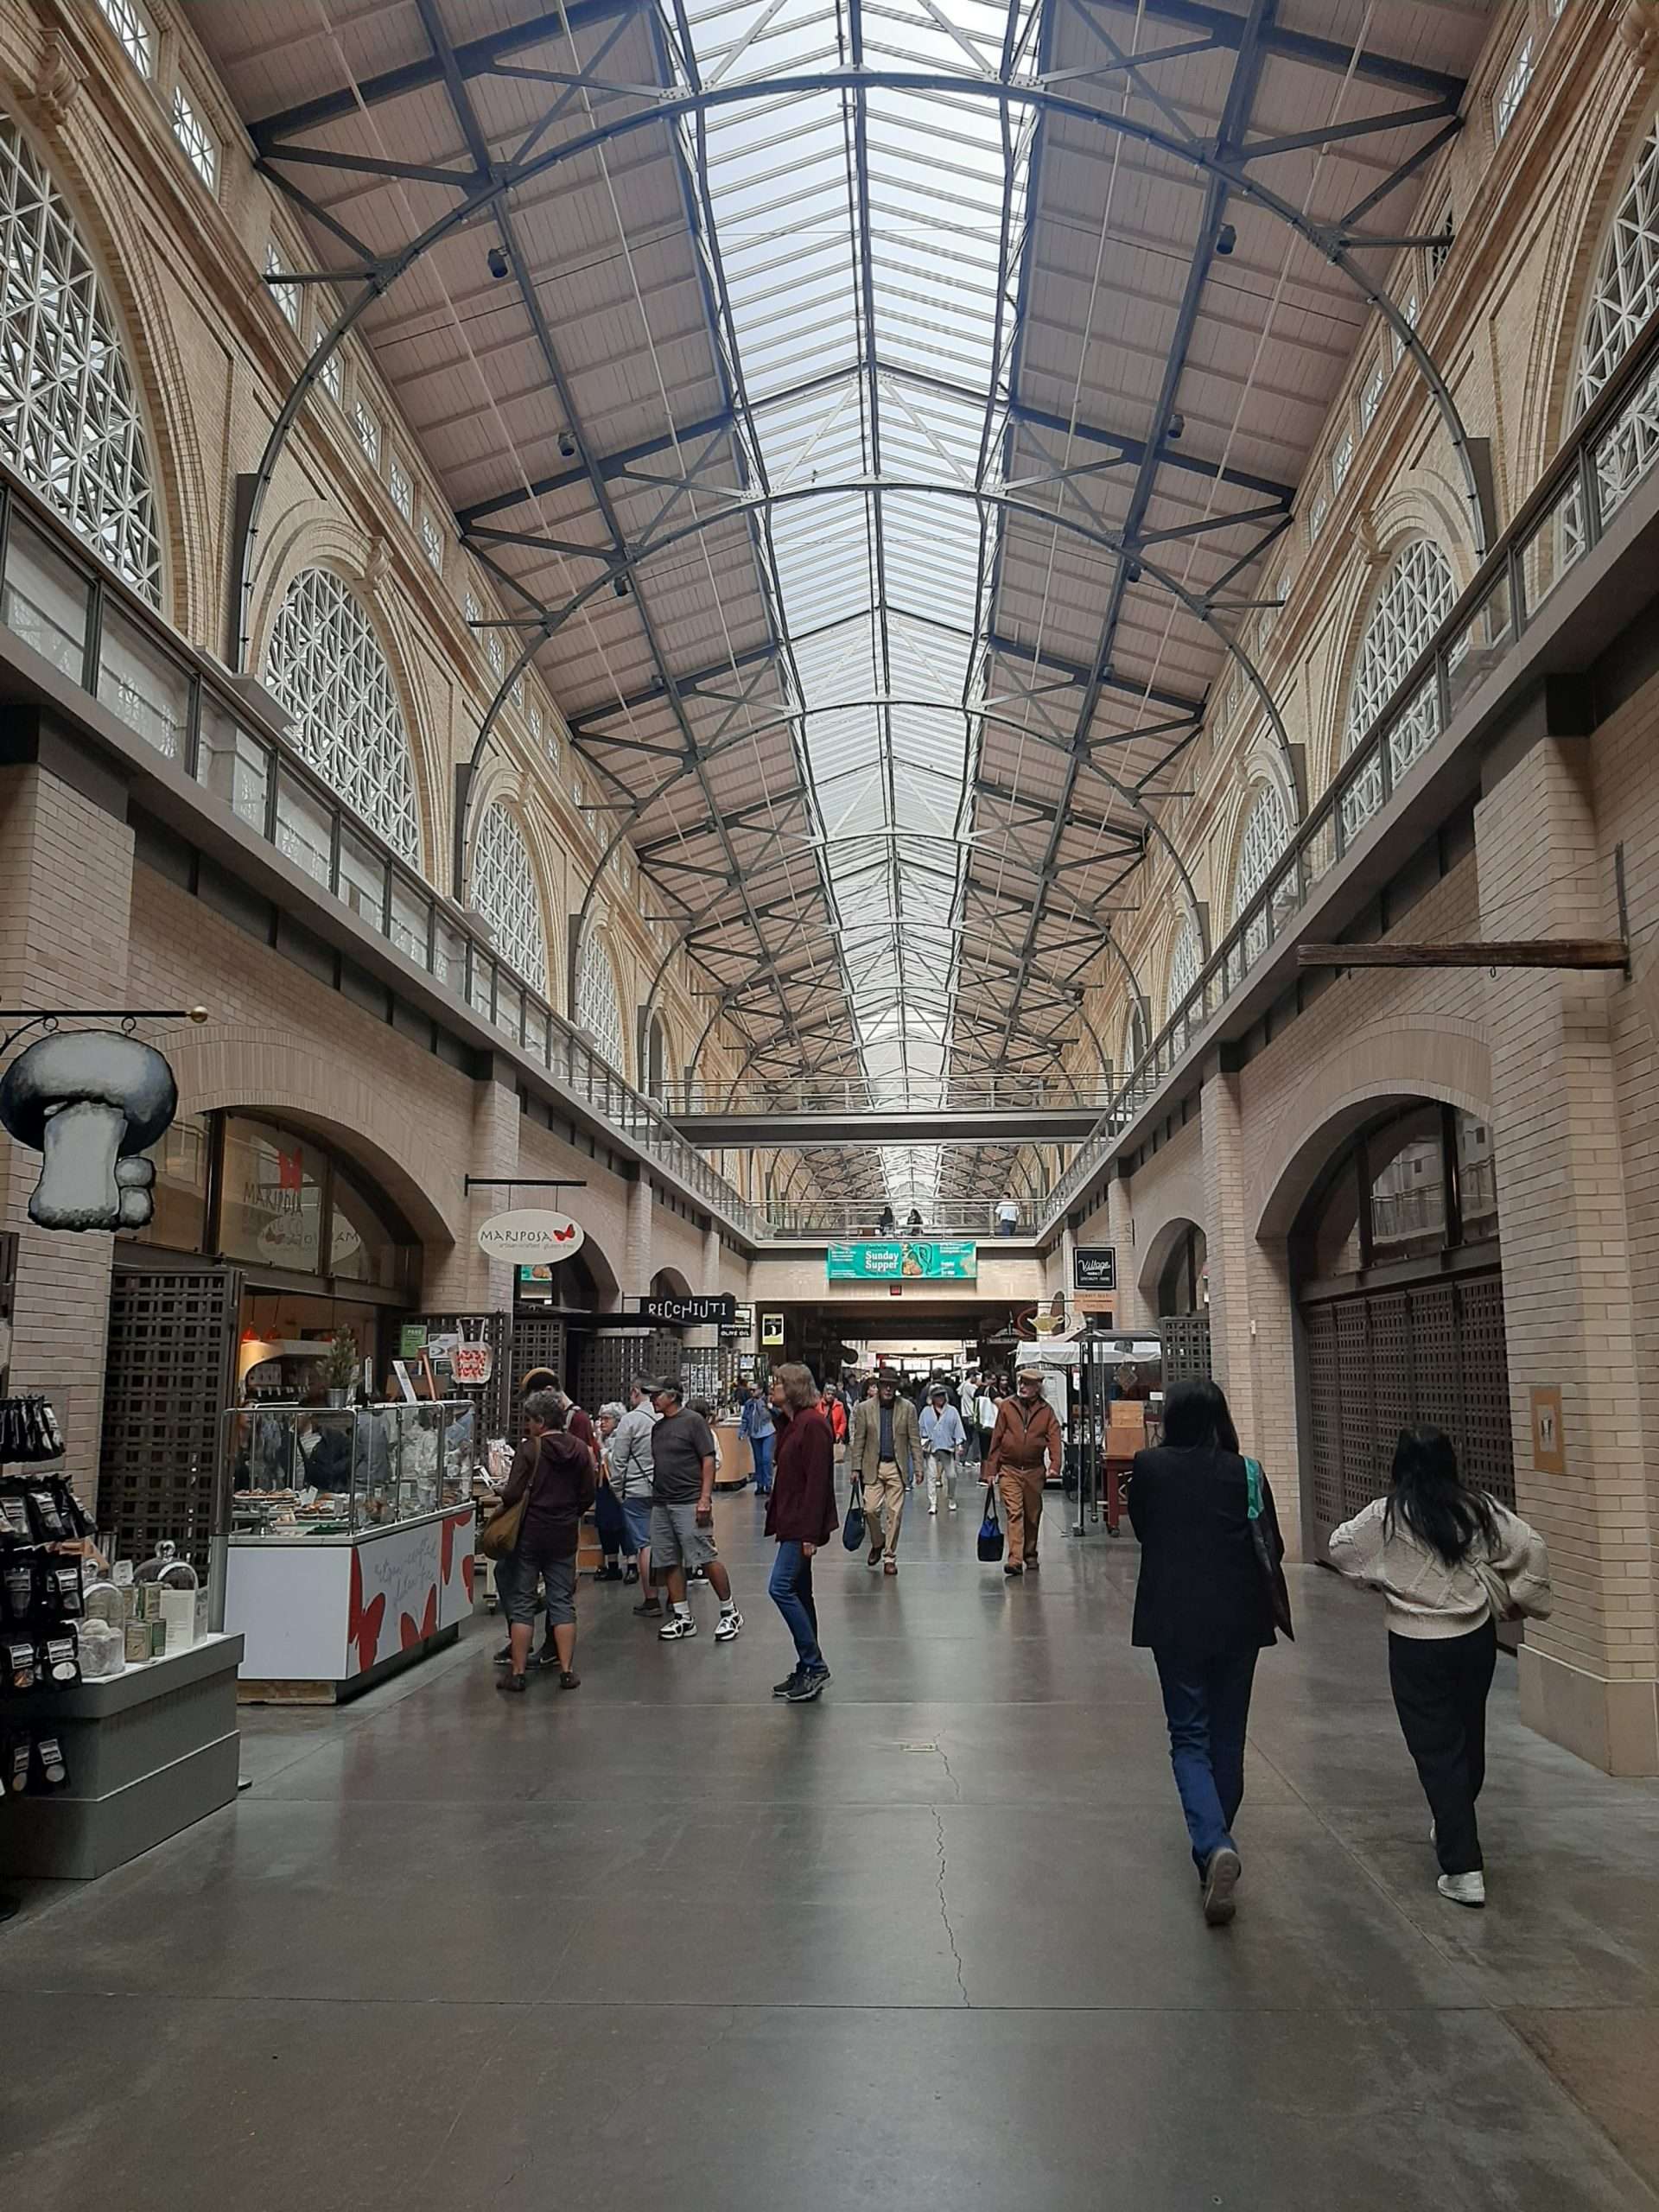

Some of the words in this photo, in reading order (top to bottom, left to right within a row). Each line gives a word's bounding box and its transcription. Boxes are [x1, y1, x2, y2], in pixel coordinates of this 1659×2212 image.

[480, 1230, 553, 1243] MARIPOSA
[865, 1250, 899, 1262] Sunday
[865, 1260, 899, 1272] Supper
[1077, 1259, 1111, 1275] Village
